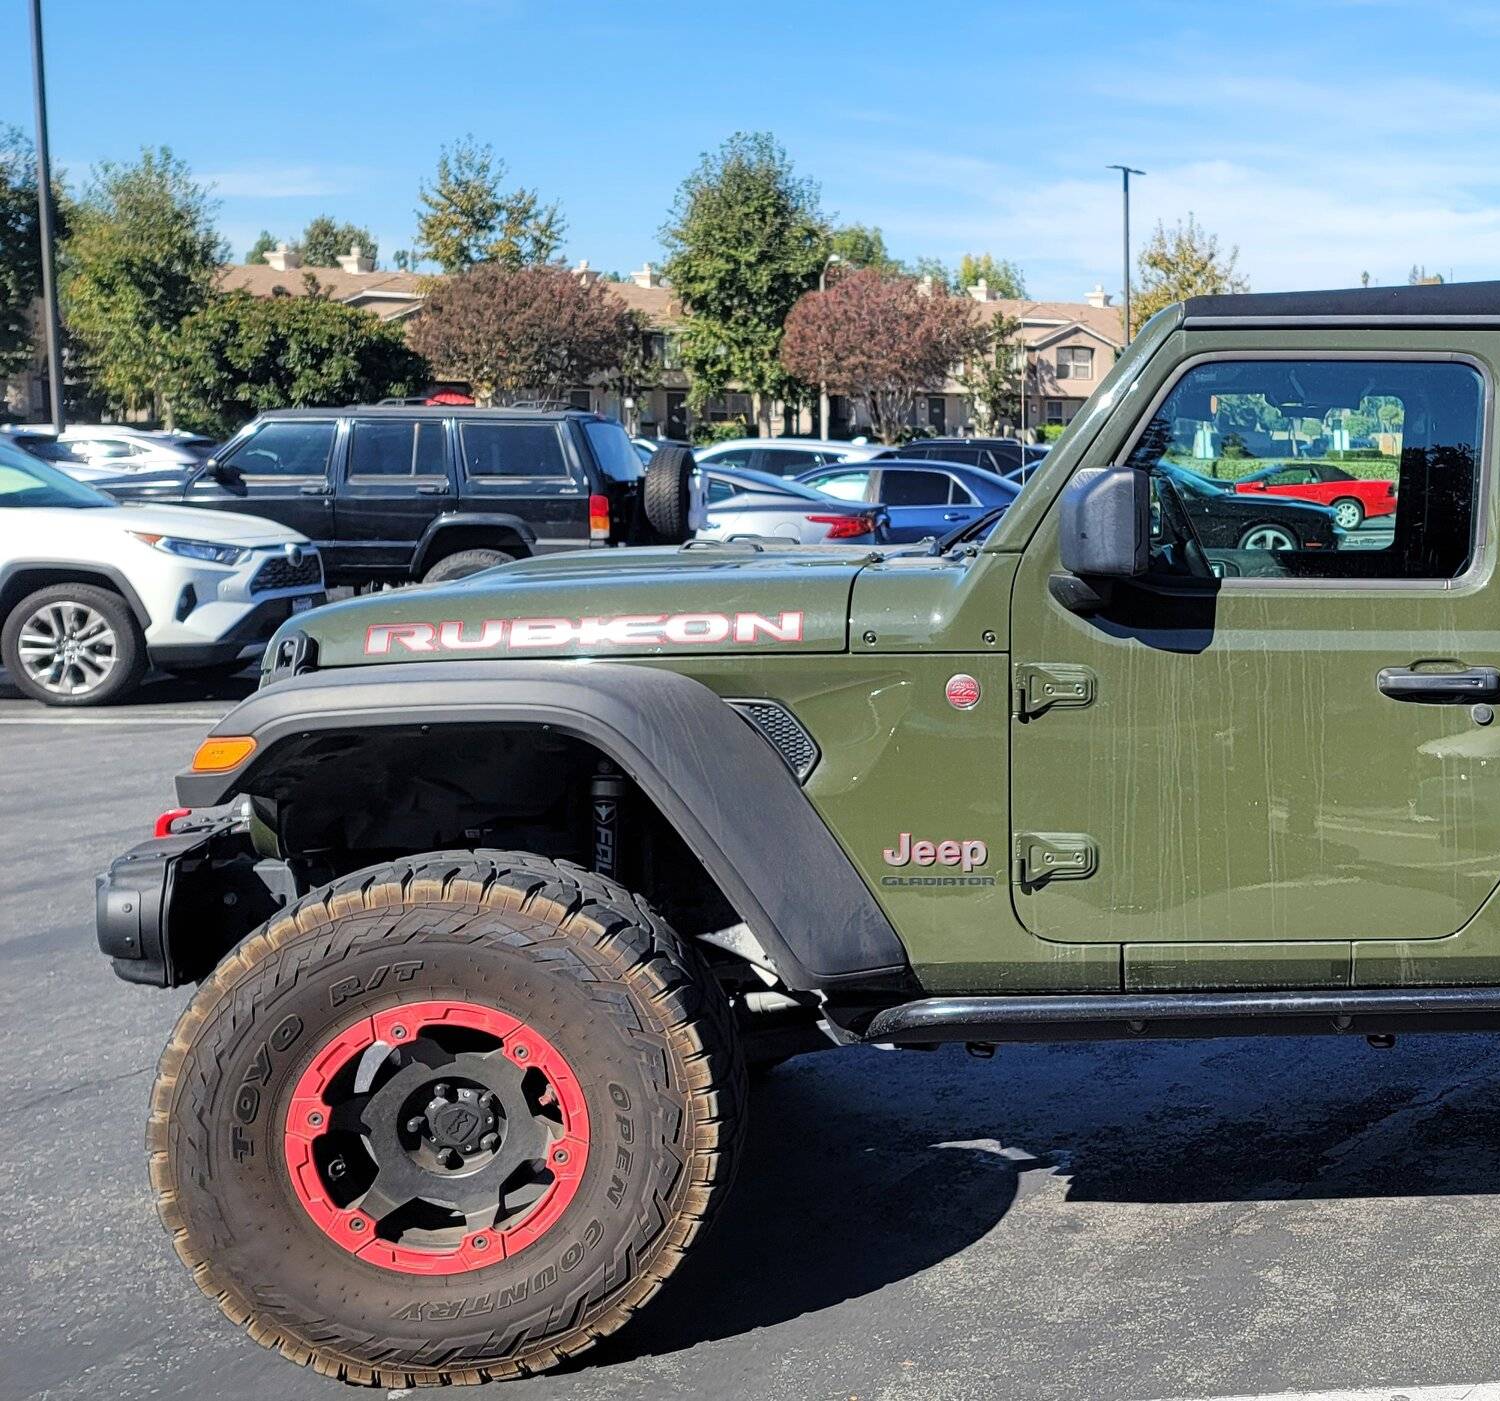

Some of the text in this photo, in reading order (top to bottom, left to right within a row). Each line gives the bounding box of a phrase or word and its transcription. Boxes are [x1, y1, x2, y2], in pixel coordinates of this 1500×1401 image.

[364, 611, 804, 656] RUBICON
[882, 832, 989, 873] Jeep
[881, 876, 995, 887] GLADIATOR
[229, 959, 425, 1164] TOYO R/T
[389, 1080, 636, 1324] OPEN COUNTRY
